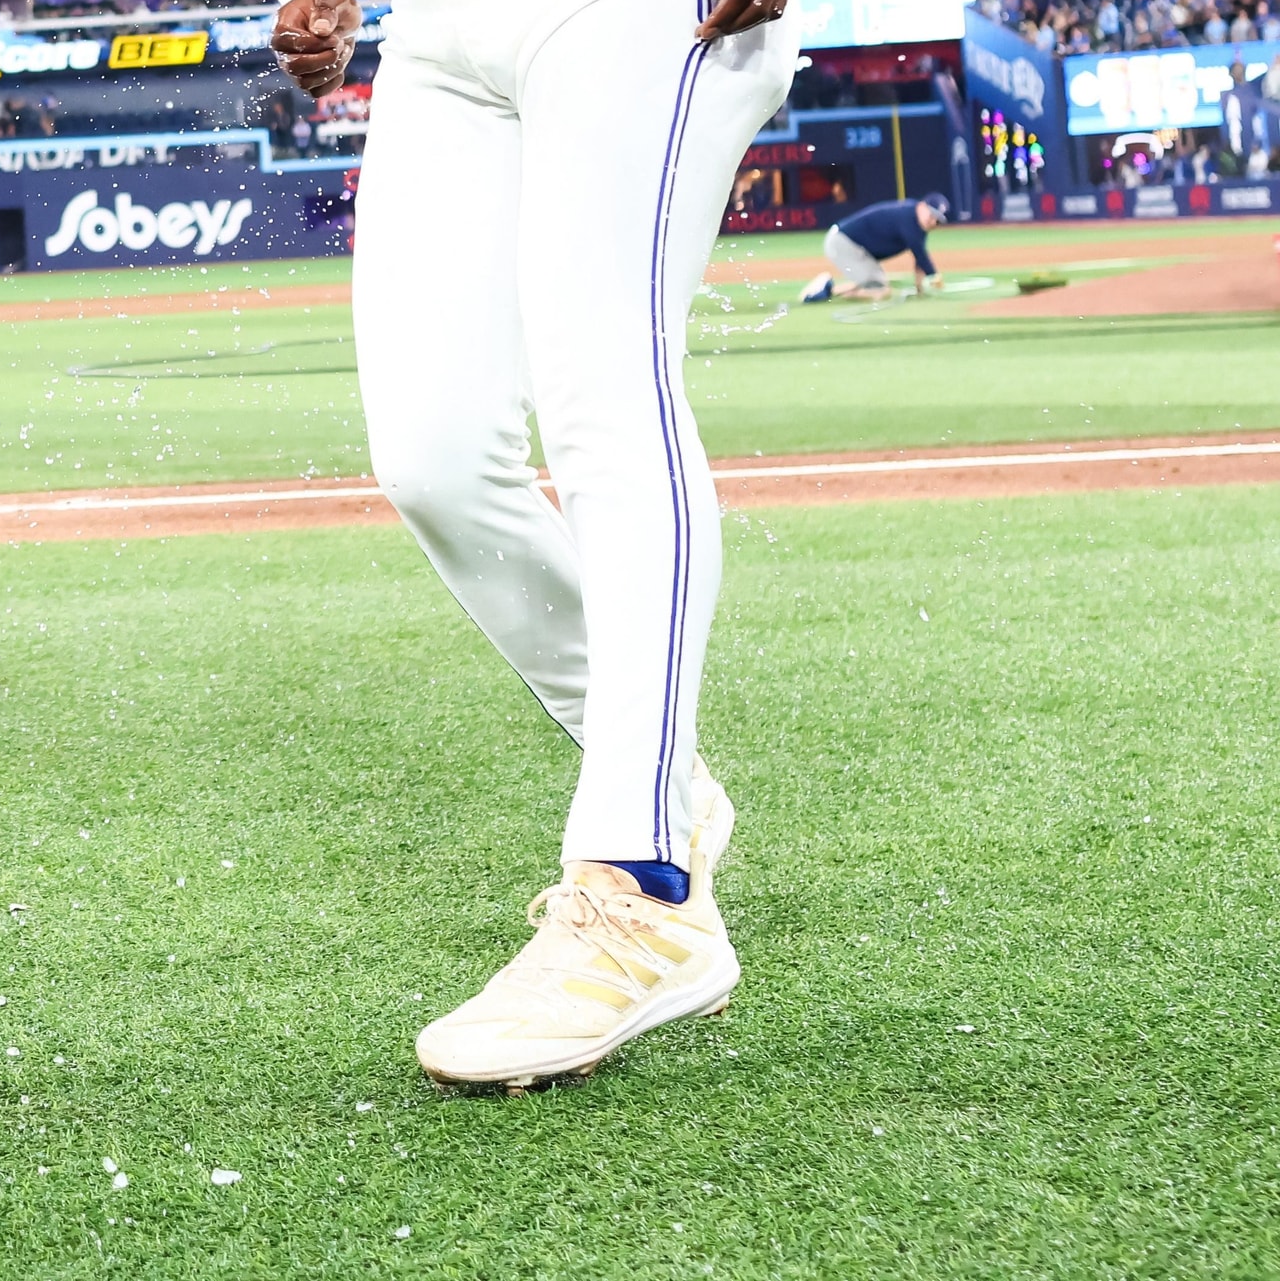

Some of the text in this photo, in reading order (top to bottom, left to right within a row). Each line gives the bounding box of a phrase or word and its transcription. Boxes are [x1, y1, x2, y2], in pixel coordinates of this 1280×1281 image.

[116, 37, 194, 64] BET
[742, 143, 814, 167] OGERS
[44, 188, 254, 258] Sobeys
[726, 207, 817, 233] ROGERS
